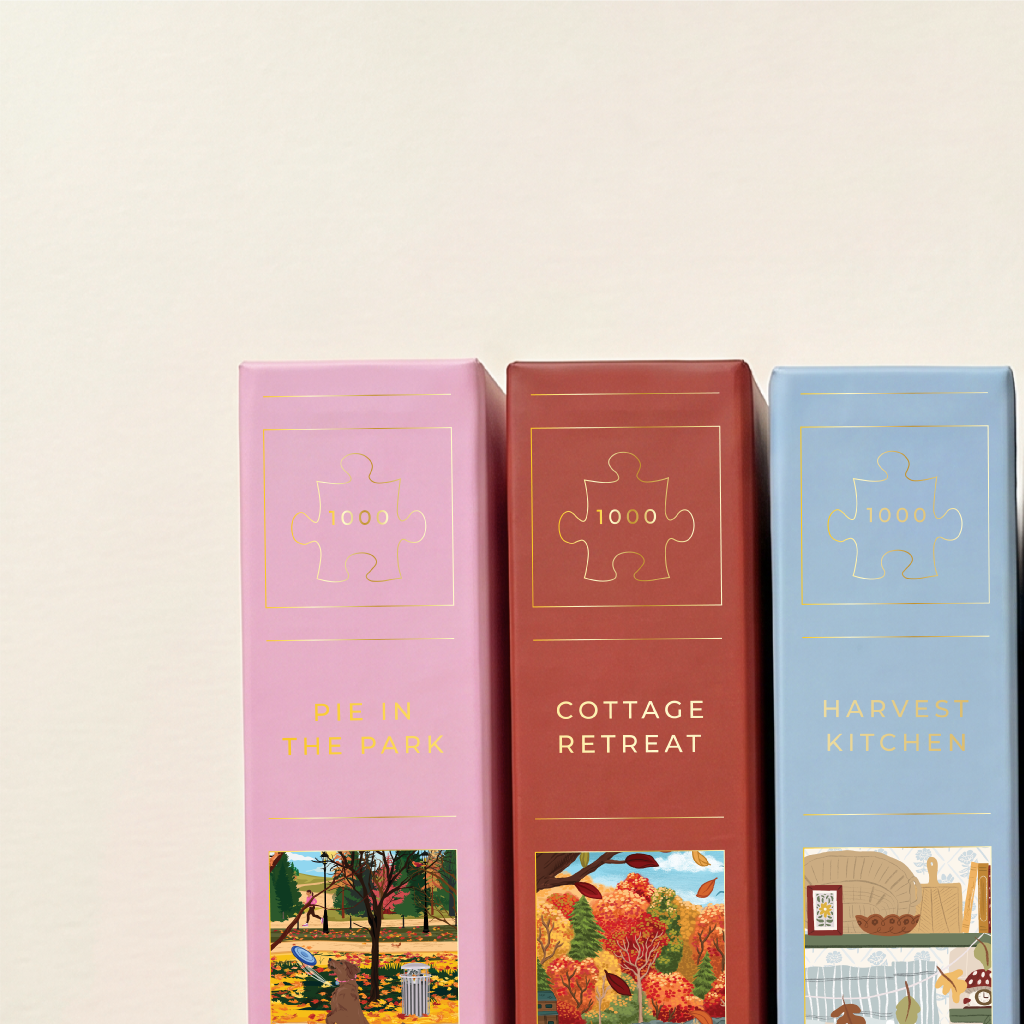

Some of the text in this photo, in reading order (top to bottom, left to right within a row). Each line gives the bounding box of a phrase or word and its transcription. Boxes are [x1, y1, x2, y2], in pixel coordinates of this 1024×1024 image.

[329, 509, 391, 526] 1000
[596, 509, 657, 525] 1000
[866, 507, 927, 523] 1000
[315, 702, 411, 722] PIE IN
[557, 700, 704, 720] COTTAGE
[824, 700, 970, 719] HARVEST
[282, 735, 445, 756] THE PARK
[559, 734, 702, 754] RETREAT
[827, 733, 966, 752] KITCHEN
